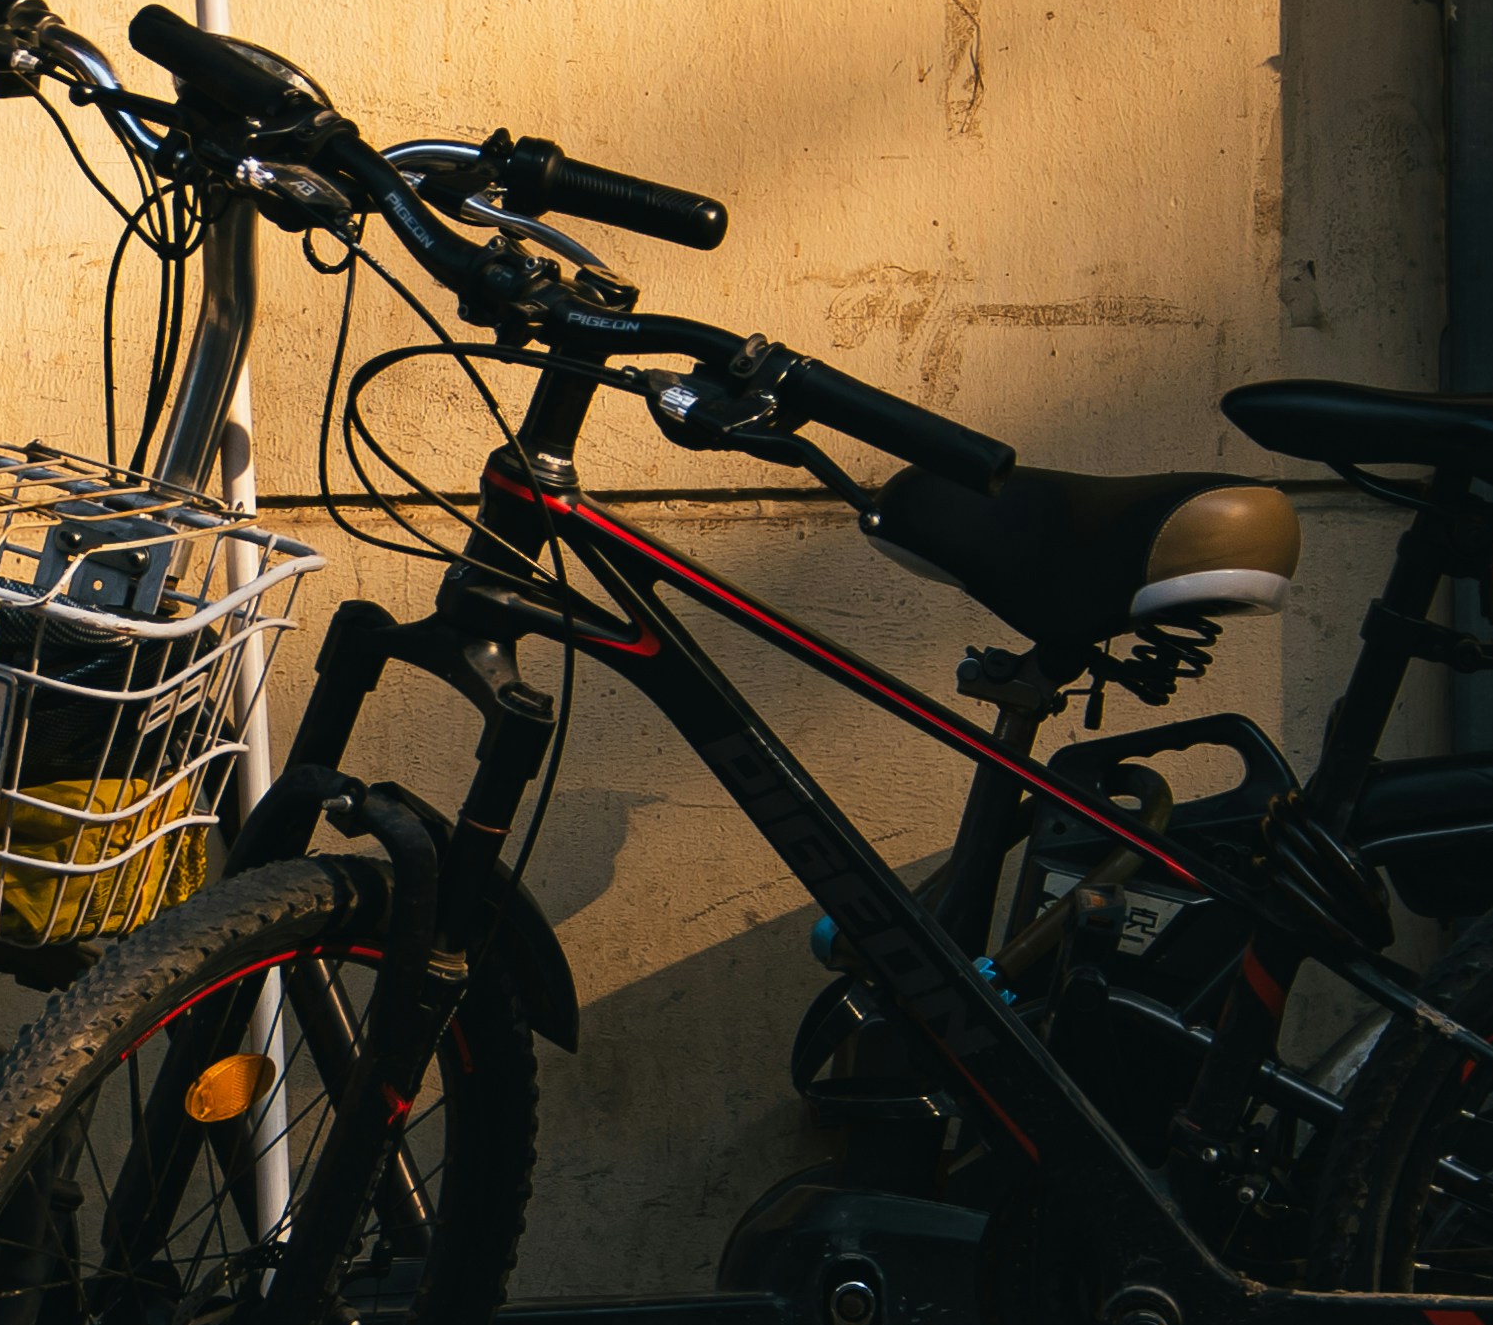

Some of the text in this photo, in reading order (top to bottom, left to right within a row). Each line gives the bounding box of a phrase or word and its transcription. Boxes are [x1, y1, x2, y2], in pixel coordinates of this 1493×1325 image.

[384, 190, 436, 249] PIGEON
[567, 311, 641, 333] PIGEON
[701, 728, 1001, 1057] PIGEON
